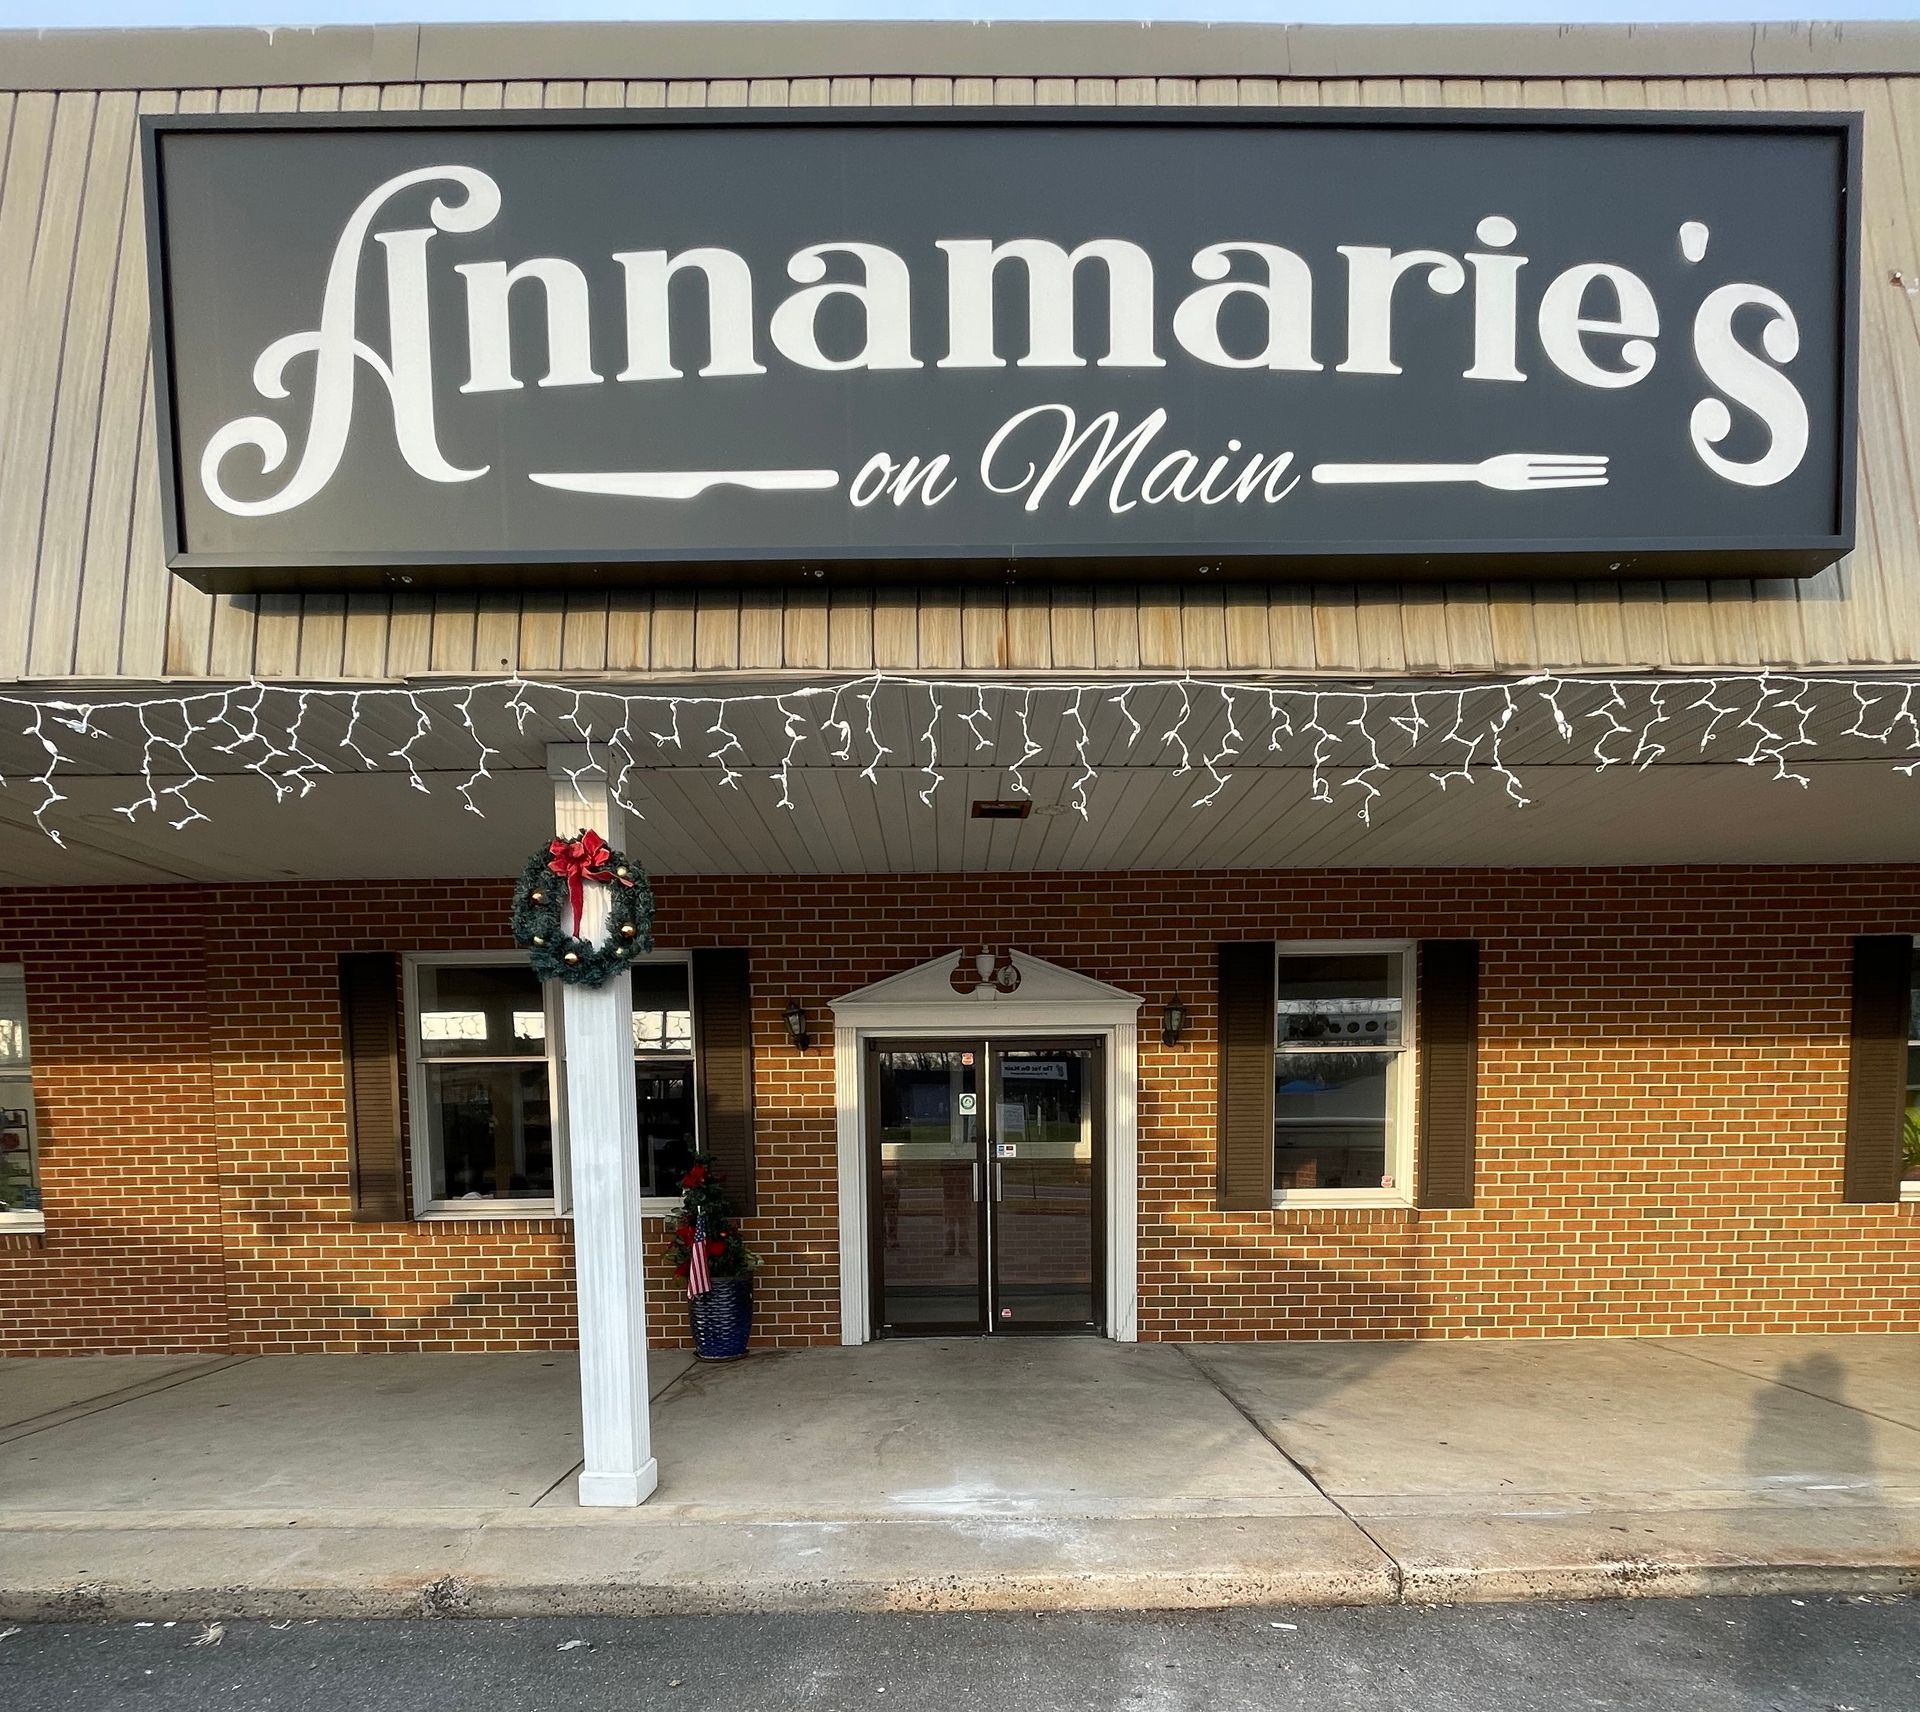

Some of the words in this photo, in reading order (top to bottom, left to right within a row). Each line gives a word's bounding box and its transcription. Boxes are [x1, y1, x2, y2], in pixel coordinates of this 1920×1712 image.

[199, 164, 1810, 517] Annamarie's
[849, 451, 958, 508] on
[980, 403, 1301, 514] Main
